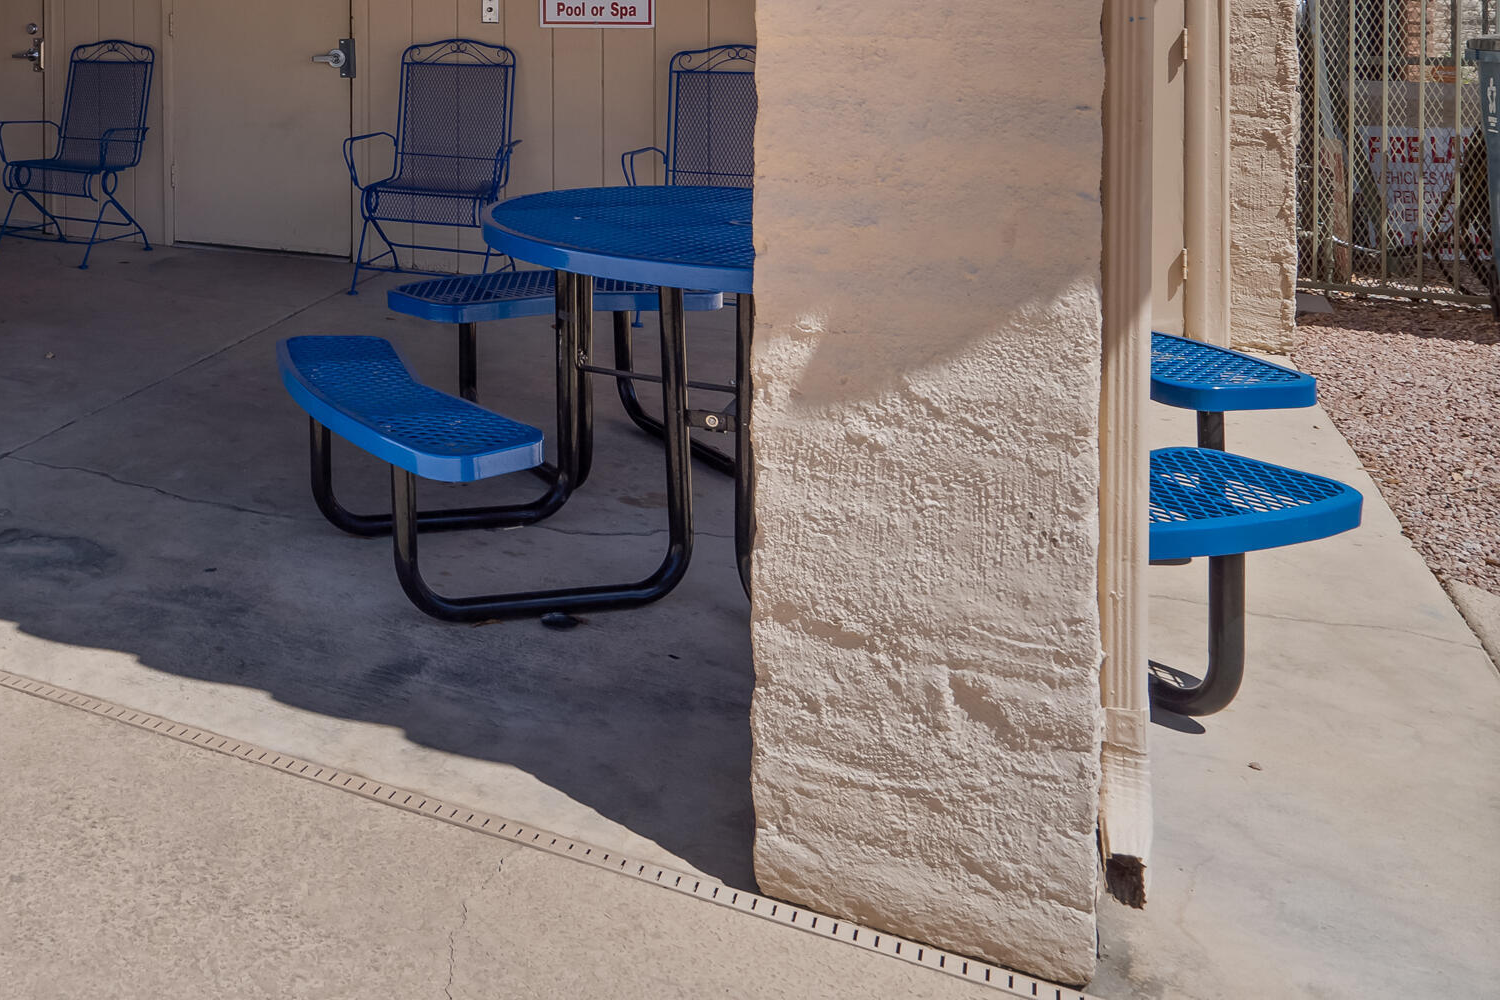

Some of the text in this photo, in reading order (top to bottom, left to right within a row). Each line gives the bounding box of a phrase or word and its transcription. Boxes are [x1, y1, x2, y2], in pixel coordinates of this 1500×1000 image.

[556, 2, 637, 19] Pool or Spa
[1368, 137, 1420, 163] FRE
